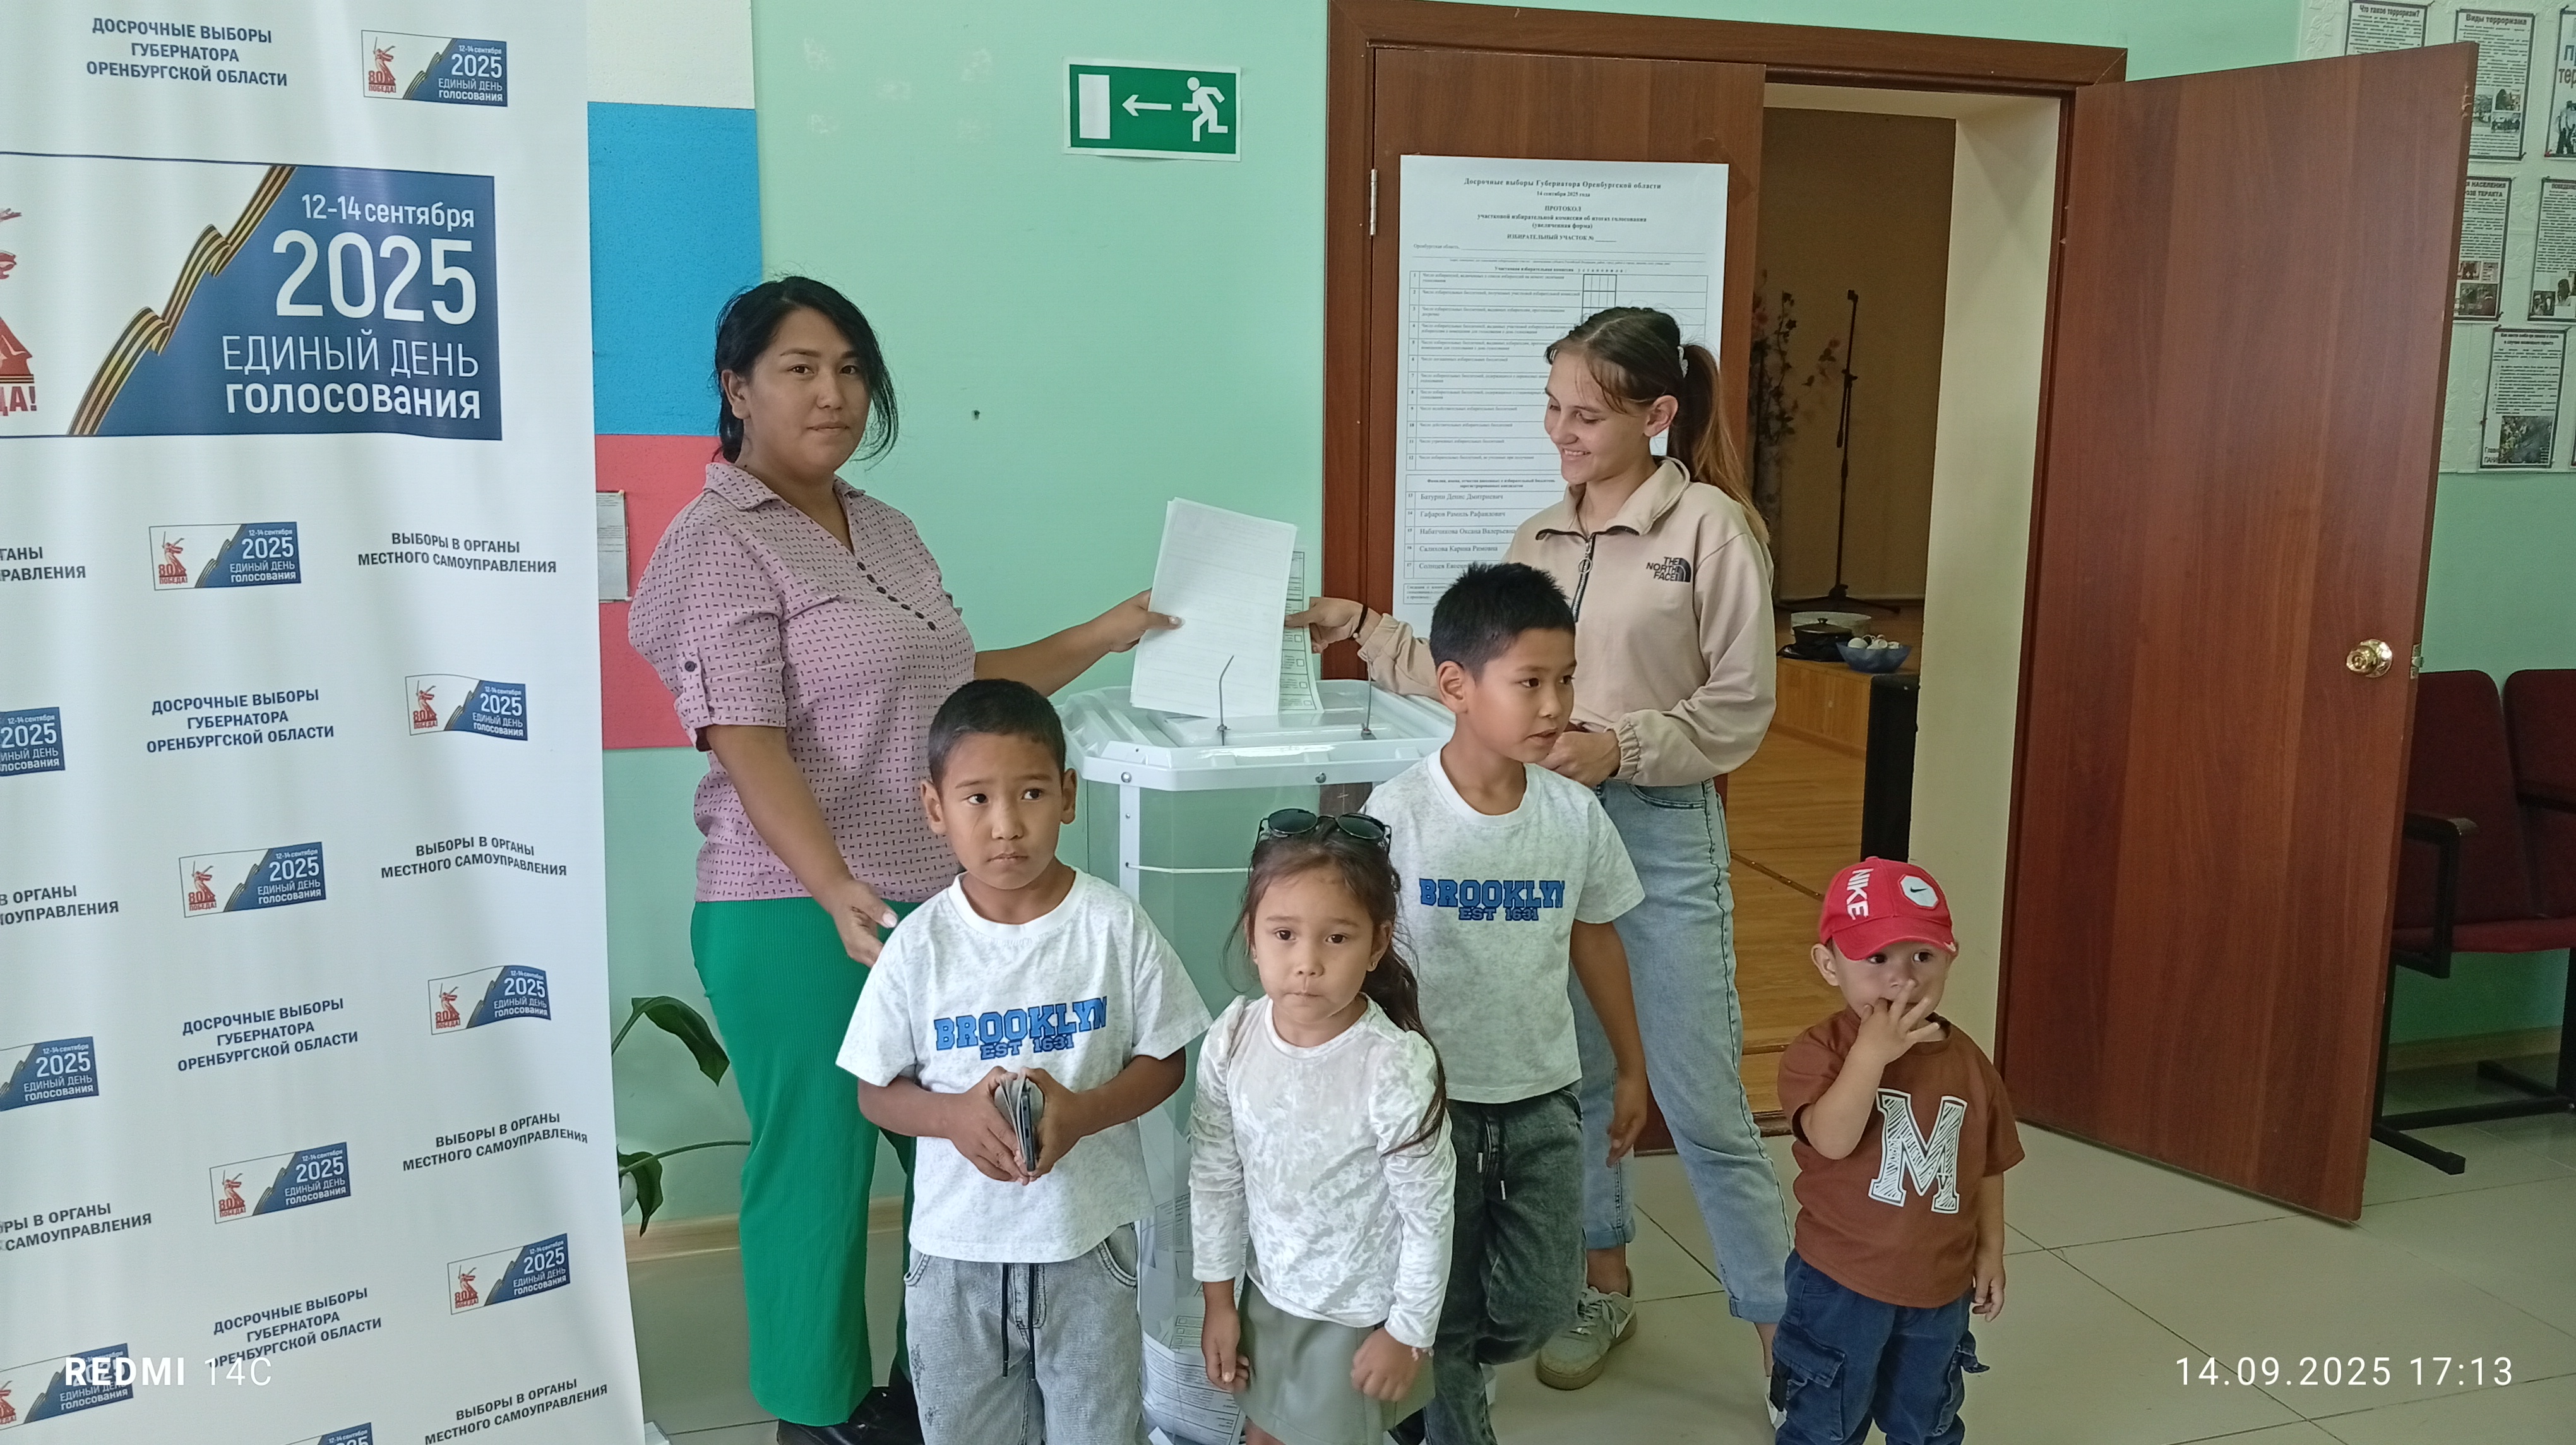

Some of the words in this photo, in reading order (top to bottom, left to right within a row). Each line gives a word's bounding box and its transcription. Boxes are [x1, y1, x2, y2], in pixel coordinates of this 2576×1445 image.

[2466, 14, 2484, 23] Виды
[92, 18, 196, 38] ДОСРОЧНЫЕ
[200, 25, 271, 43] ВЫБОРЫ
[131, 43, 239, 63] ГУБЕРНАТОРА
[86, 61, 212, 81] ОРЕНБУРГСКОЙ
[217, 69, 287, 87] ОБЛАСТИ
[451, 54, 503, 78] 2025
[369, 85, 396, 93] ПОБЕДА!
[439, 78, 477, 90] ЕДИНЫЙ
[479, 81, 503, 91] ДЕНЬ
[439, 90, 503, 102] голосования
[302, 193, 361, 220] 12-14
[365, 202, 474, 232] сентября
[273, 229, 477, 325] 2025
[222, 329, 379, 375] ЕДИНЫЙ
[391, 339, 479, 378] ДЕНЬ
[226, 383, 480, 419] голосования
[242, 537, 294, 559] 2025
[392, 533, 448, 548] ВЫБОРЫ
[453, 539, 460, 549] В
[464, 540, 520, 553] ОРГАНЫ
[230, 560, 268, 573] ЕДИНЫЙ
[271, 561, 295, 572] ДЕНЬ
[358, 552, 429, 565] МЕСТНОГО
[433, 553, 556, 573] САМОУПРАВЛЕНИЯ
[1646, 563, 1677, 573] NORTH
[1664, 556, 1679, 565] THE
[231, 572, 295, 582] голосования
[1654, 572, 1676, 581] FACE
[152, 695, 248, 715] ДОСРОЧНЫЕ
[253, 690, 319, 705] ВЫБОРЫ
[480, 693, 522, 716] 2025
[188, 711, 288, 729] ГУБЕРНАТОРА
[473, 712, 501, 724] ЕДИНЫЙ
[503, 718, 523, 727] ДЕНЬ
[474, 723, 523, 736] голосования
[1, 722, 57, 748] 2025
[147, 729, 263, 753] ОРЕНБУРГСКОЙ
[268, 726, 334, 742] ОБЛАСТИ
[33, 748, 58, 759] ДЕНЬ
[416, 837, 474, 856] ВЫБОРЫ
[479, 836, 487, 846] В
[492, 837, 534, 856] ОРГАНЫ
[269, 856, 319, 882] 2025
[381, 858, 451, 878] МЕСТНОГО
[455, 854, 567, 875] САМОУПРАВЛЕНИЯ
[13, 885, 77, 904] ОРГАНЫ
[258, 882, 295, 896] ЕДИНЫЙ
[297, 879, 320, 890] ДЕНЬ
[259, 889, 321, 904] голосования
[1846, 868, 1874, 921] NIKE
[1458, 907, 1496, 921] EST
[1505, 908, 1539, 921] 1631
[504, 978, 546, 998] 2025
[494, 997, 527, 1009] ЕДИНЫЙ
[529, 998, 547, 1008] ДЕНЬ
[495, 1007, 547, 1018] голосования
[183, 1009, 275, 1036] ДОСРОЧНЫЕ
[280, 998, 343, 1019] ВЫБОРЫ
[934, 996, 1107, 1051] BROOKLYN
[217, 1021, 314, 1046] ГУБЕРНАТОРА
[178, 1041, 290, 1071] ОРЕНБУРГСКОЙ
[294, 1031, 358, 1052] ОБЛАСТИ
[980, 1040, 1022, 1060] EST
[1033, 1033, 1075, 1053] 1631
[36, 1052, 91, 1077] 2025
[24, 1077, 64, 1092] ЕДИНЫЙ
[68, 1075, 93, 1086] ДЕНЬ
[25, 1085, 93, 1101] голосования
[436, 1127, 495, 1148] ВЫБОРЫ
[499, 1124, 508, 1134] В
[511, 1113, 559, 1131] ОРГАНЫ
[403, 1148, 472, 1171] МЕСТНОГО
[477, 1129, 588, 1156] САМОУПРАВЛЕНИЯ
[1868, 1088, 1967, 1214] M
[296, 1156, 344, 1184] 2025
[285, 1182, 321, 1196] ЕДИНЫЙ
[323, 1178, 345, 1189] ДЕНЬ
[285, 1186, 346, 1205] голосования
[33, 1214, 44, 1226] В
[49, 1203, 110, 1223] ОРГАНЫ
[6, 1213, 152, 1251] САМОУПРАВЛЕНИЯ
[523, 1247, 565, 1274] 2025
[513, 1271, 545, 1288] ЕДИНЫЙ
[547, 1268, 566, 1280] ДЕНЬ
[514, 1275, 566, 1295] голосования
[213, 1302, 302, 1335] ДОСРОЧНЫЕ
[306, 1288, 367, 1311] ВЫБОРЫ
[247, 1311, 340, 1343] ГУБЕРНАТОРА
[321, 1317, 381, 1341] ОБЛАСТИ
[61, 1389, 128, 1410] голосования
[456, 1396, 513, 1421] ВЫБОРЫ
[516, 1393, 524, 1403] В
[528, 1378, 577, 1401] ОРГАНЫ
[425, 1418, 490, 1445] МЕСТНОГО
[495, 1384, 607, 1425] САМОУПРАВЛЕНИЯ
